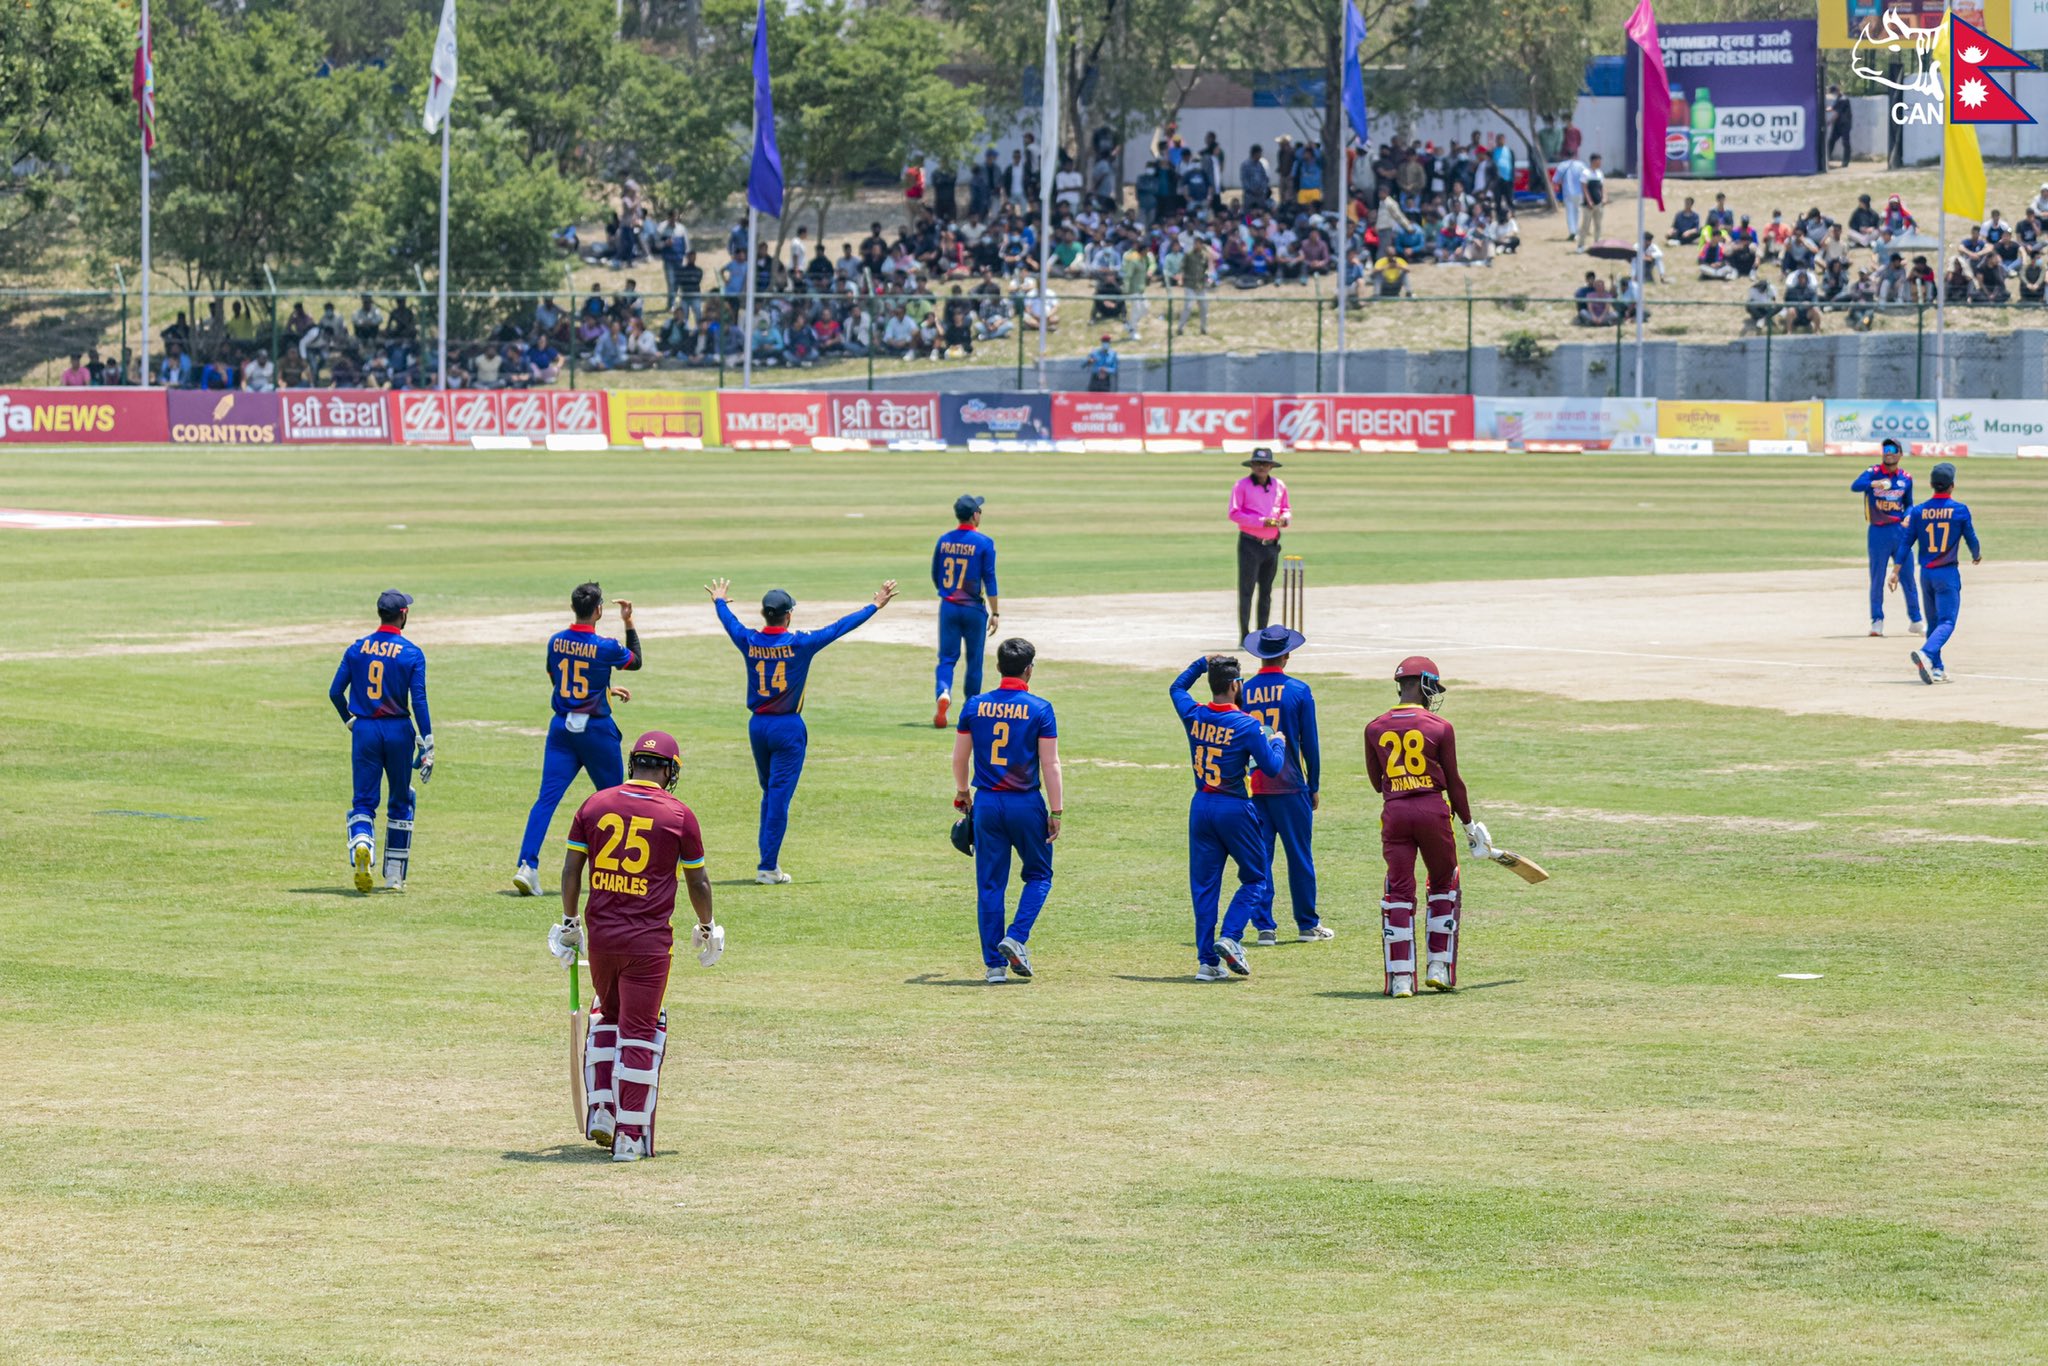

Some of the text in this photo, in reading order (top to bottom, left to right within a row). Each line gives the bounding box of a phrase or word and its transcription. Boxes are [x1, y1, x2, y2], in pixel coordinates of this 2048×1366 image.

[2034, 1, 2048, 13] H
[1679, 48, 1794, 67] REFRESHING
[1721, 111, 1797, 128] 400 ml
[291, 396, 322, 427] श्री
[842, 398, 872, 428] श्री
[1175, 408, 1249, 434] KFC
[1336, 408, 1456, 436] FIBERNET
[1872, 415, 1930, 431] COCO
[172, 424, 275, 443] CORNITOS
[1984, 418, 2044, 436] Mango
[1921, 508, 1955, 519] ROHIT
[940, 541, 976, 556] PRATISH
[1925, 521, 1951, 553] 17
[943, 557, 969, 589] 37
[360, 639, 404, 658] AASIF
[553, 638, 598, 659] GULSHAN
[748, 645, 796, 659] BHURTEL
[367, 660, 384, 700] 9
[558, 658, 590, 699] 15
[755, 660, 788, 697] 14
[1246, 684, 1286, 705] LALIT
[977, 701, 1030, 720] KUSHAL
[990, 721, 1010, 767] 2
[1190, 720, 1235, 746] AIREE
[1378, 729, 1427, 778] 28
[1193, 745, 1223, 788] 45
[594, 812, 654, 874] 25
[591, 871, 649, 896] CHARLES
